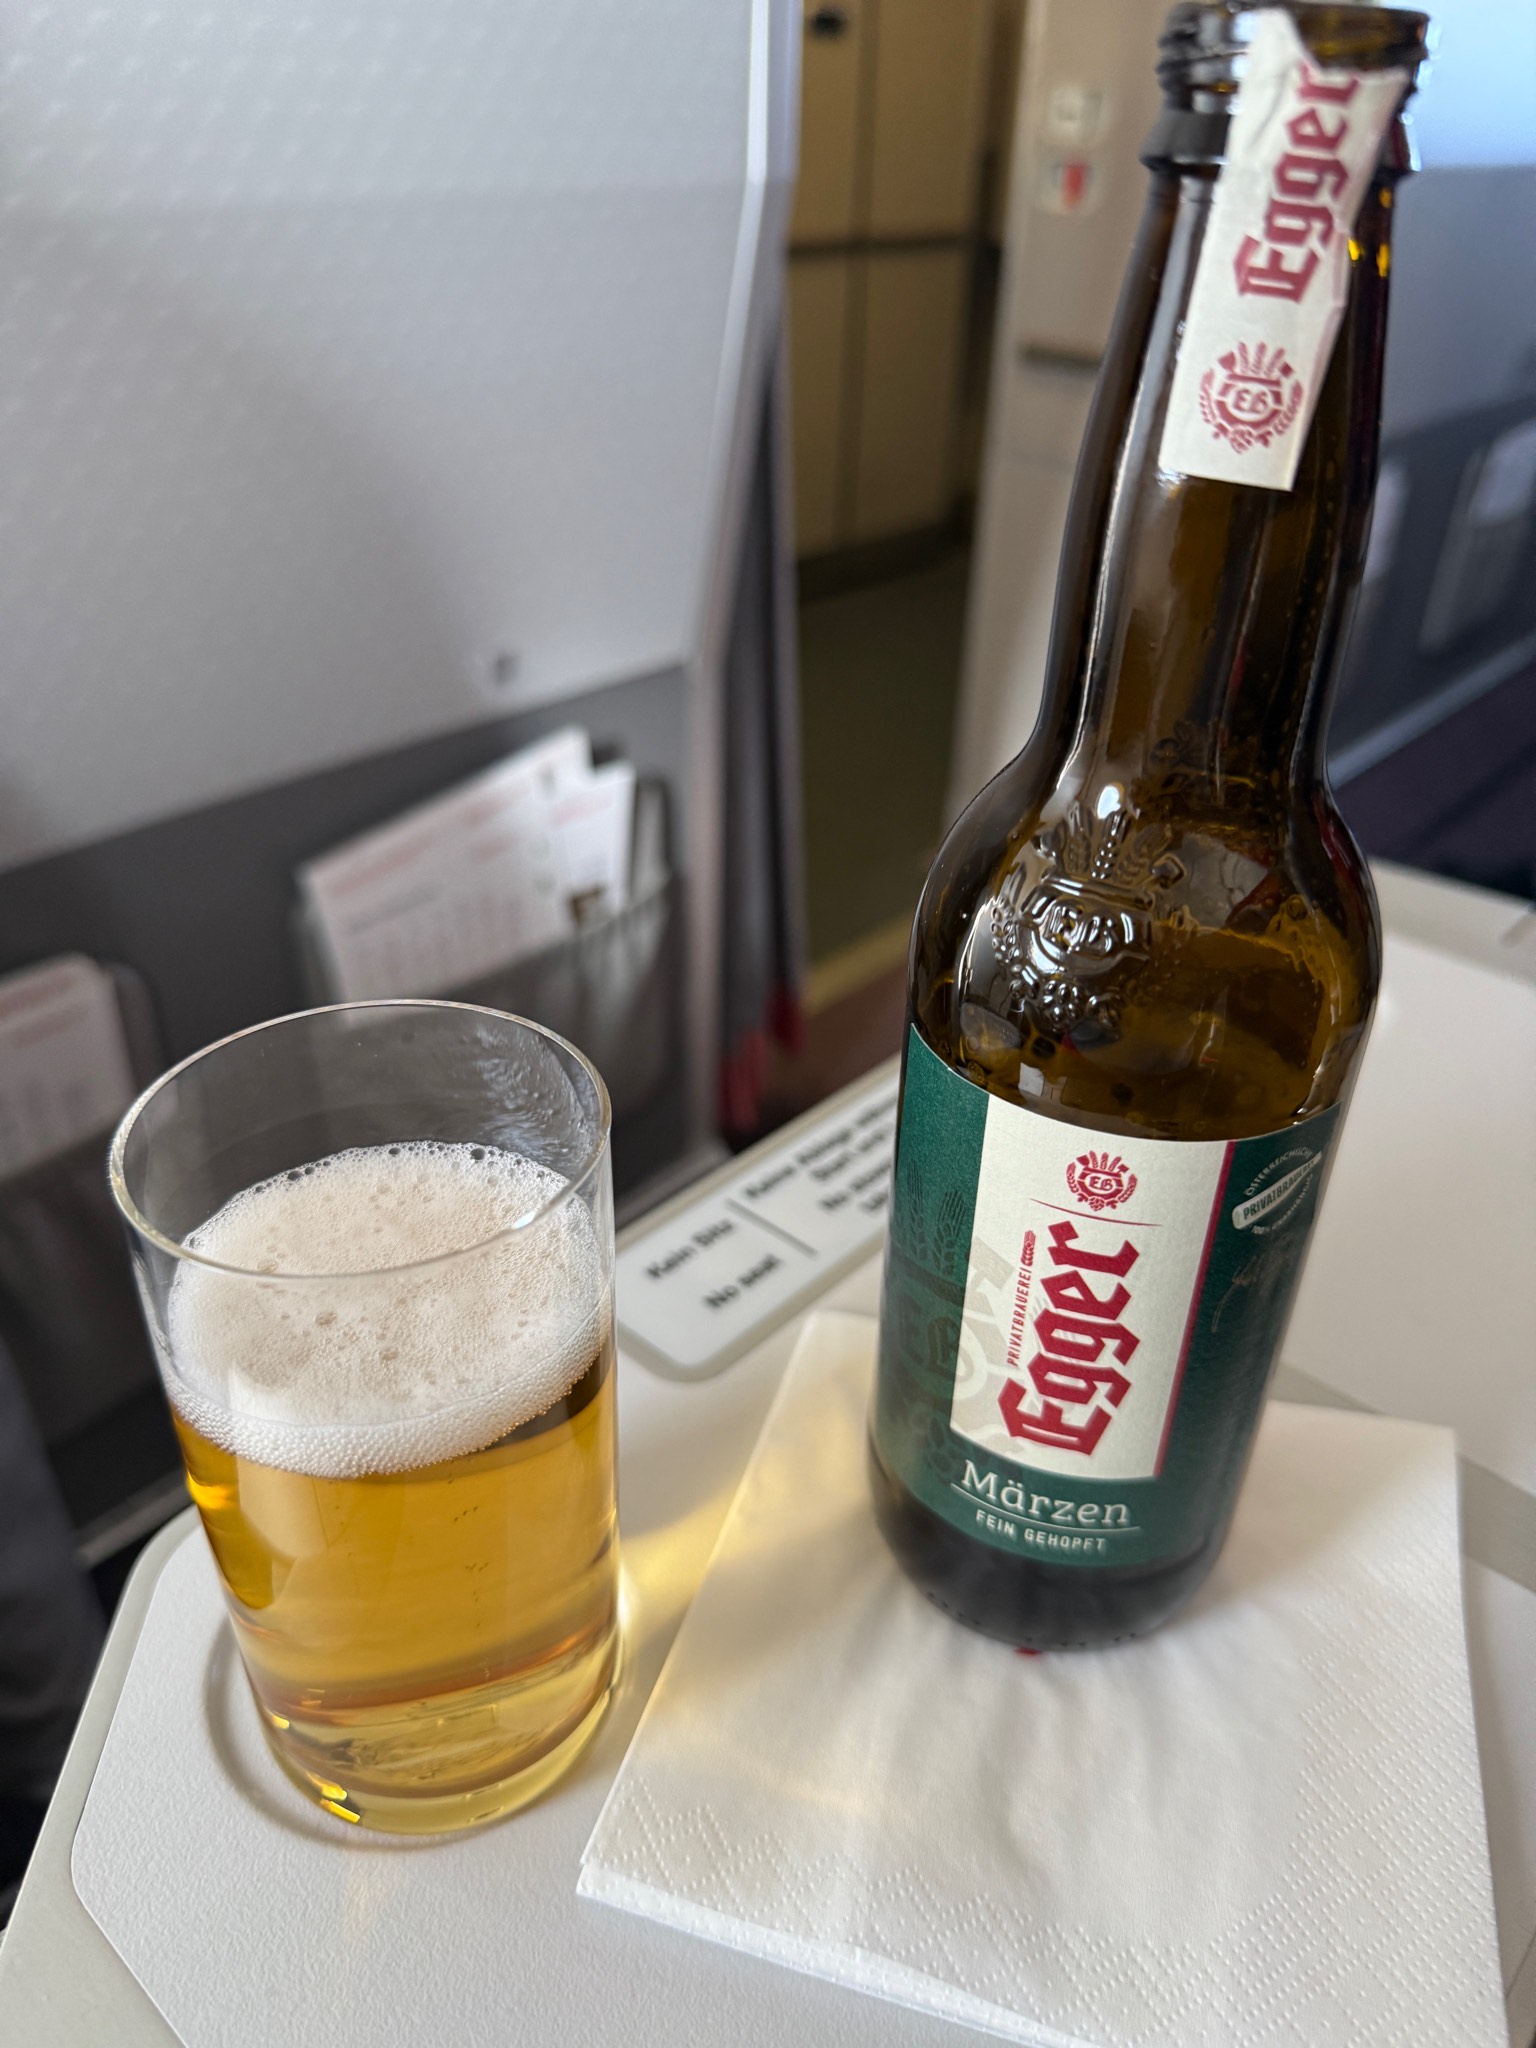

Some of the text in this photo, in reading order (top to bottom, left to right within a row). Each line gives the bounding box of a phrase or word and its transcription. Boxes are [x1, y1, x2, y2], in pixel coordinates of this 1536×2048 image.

[1233, 59, 1360, 303] Egger
[646, 1245, 697, 1280] Kein
[703, 1283, 740, 1310] No
[1007, 1267, 1032, 1368] PRIVATBRAUEREI
[997, 1220, 1140, 1456] Egger
[961, 1459, 1129, 1524] Märzen
[976, 1509, 1107, 1551] FEIN GEHOPFT
